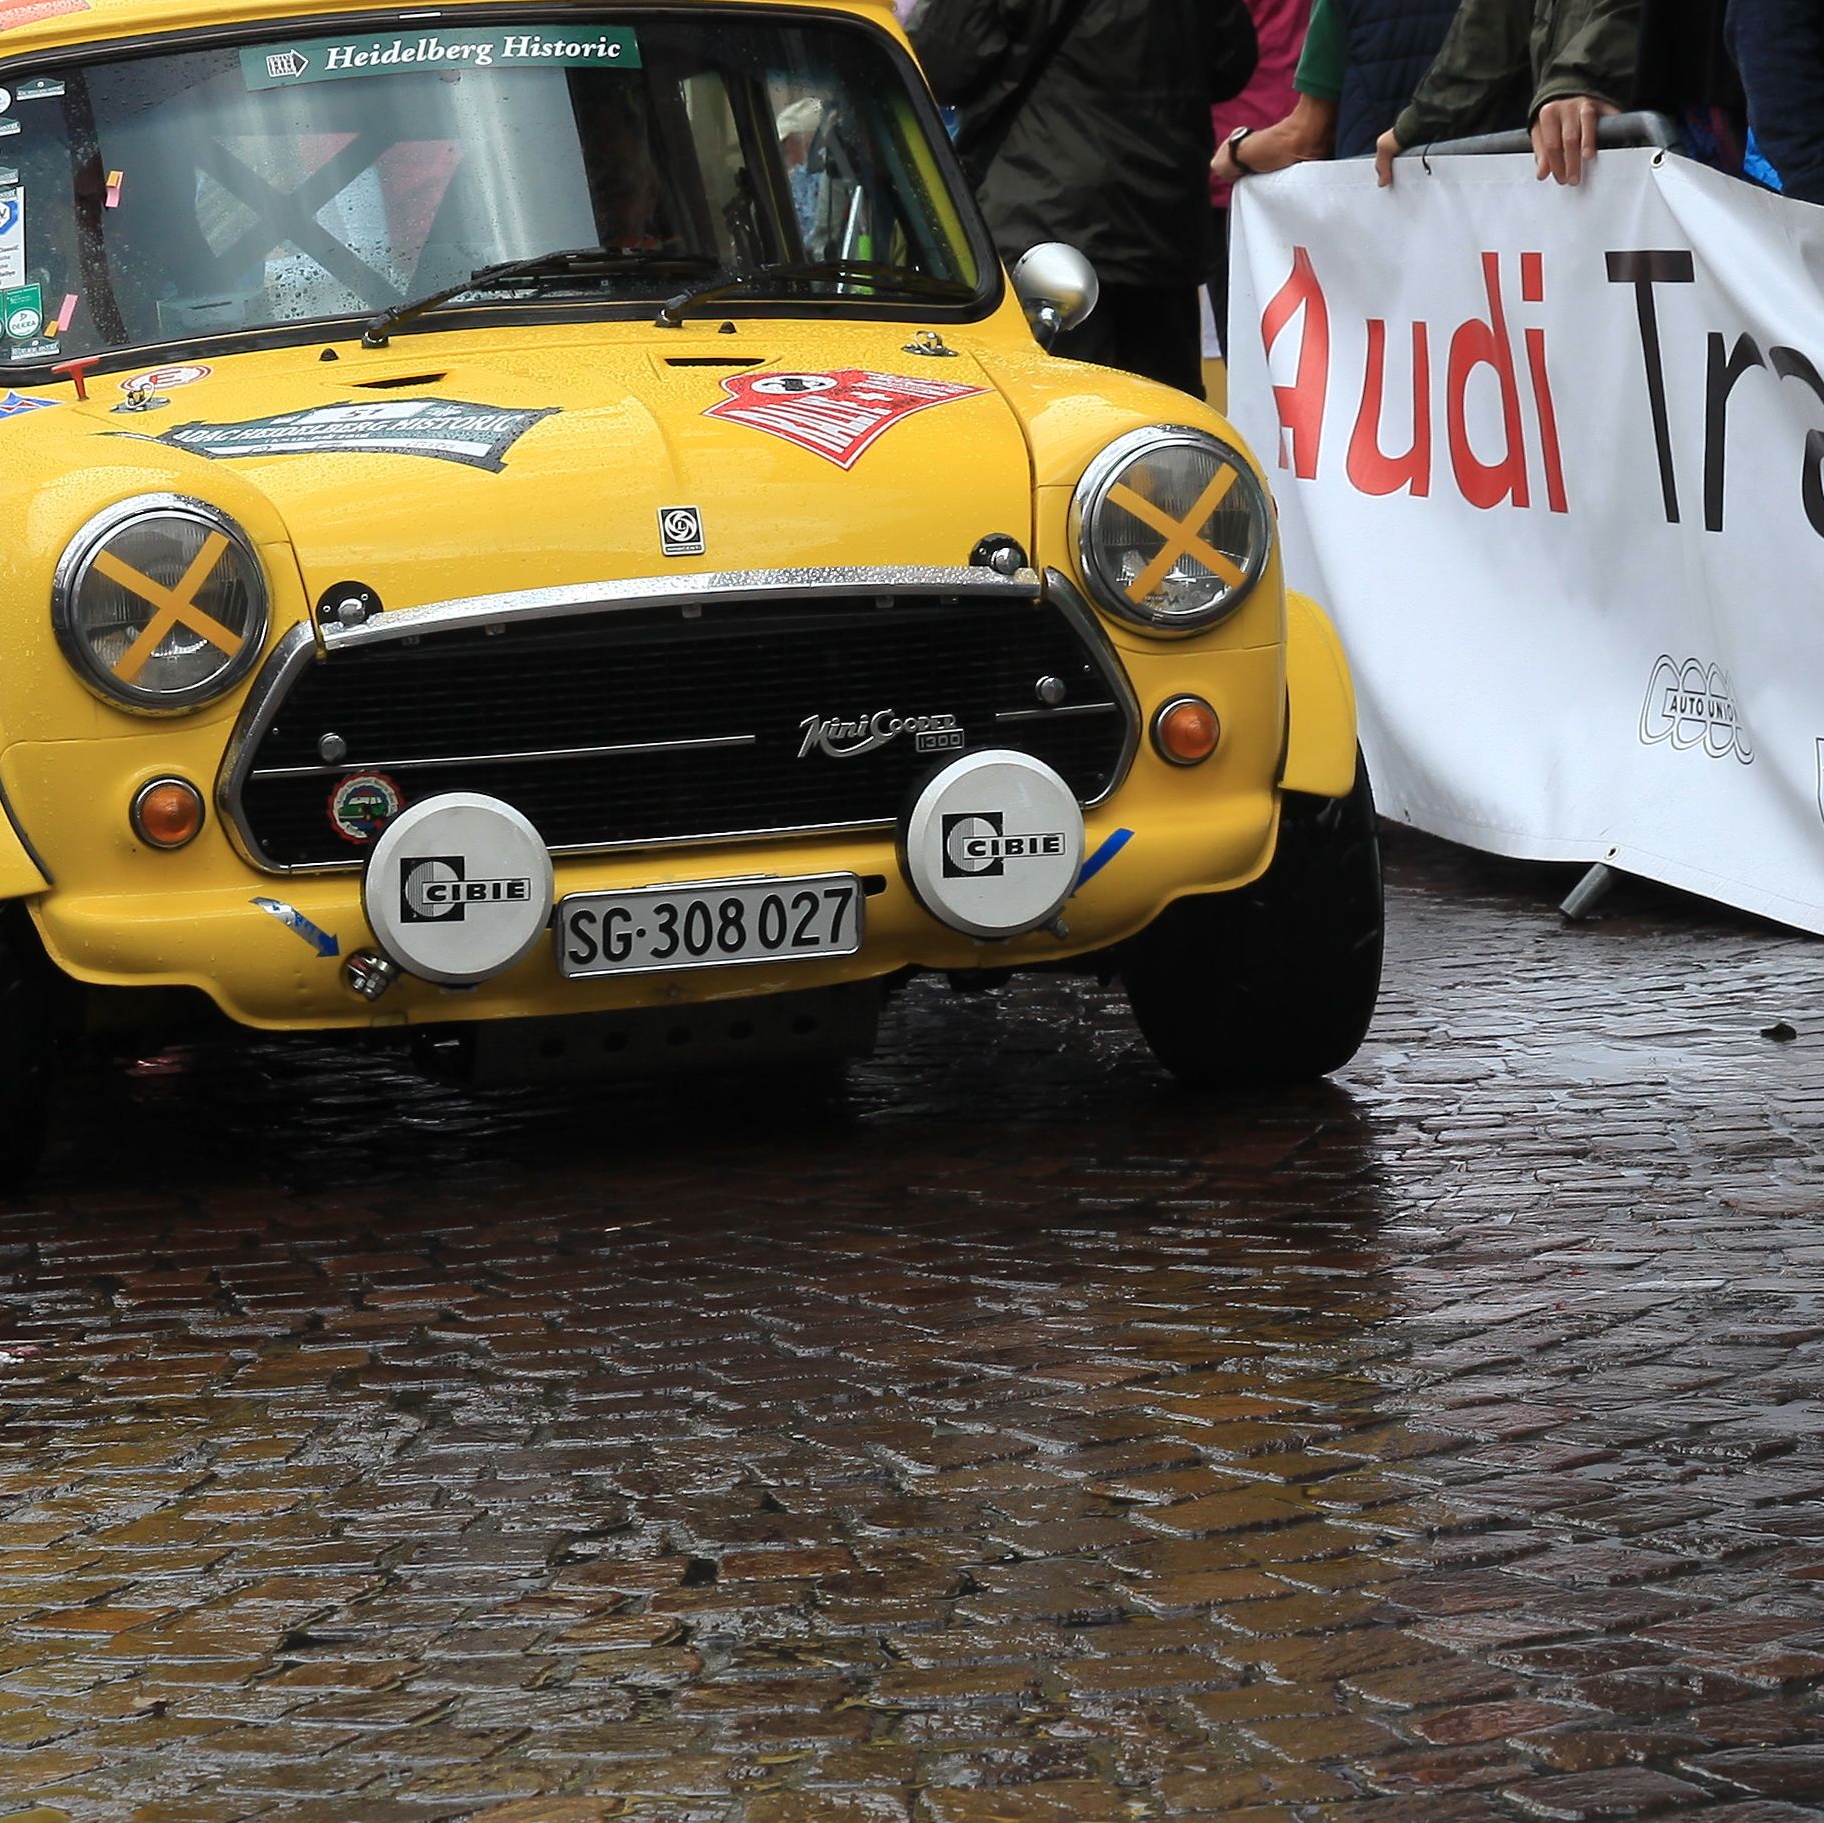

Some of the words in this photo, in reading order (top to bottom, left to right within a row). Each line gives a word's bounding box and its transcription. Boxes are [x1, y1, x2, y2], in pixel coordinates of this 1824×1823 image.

[324, 37, 494, 72] Heidelberg
[501, 34, 621, 60] Historic
[1261, 244, 1570, 515] Audi
[1669, 693, 1706, 718] AUTO
[919, 733, 962, 750] 1300
